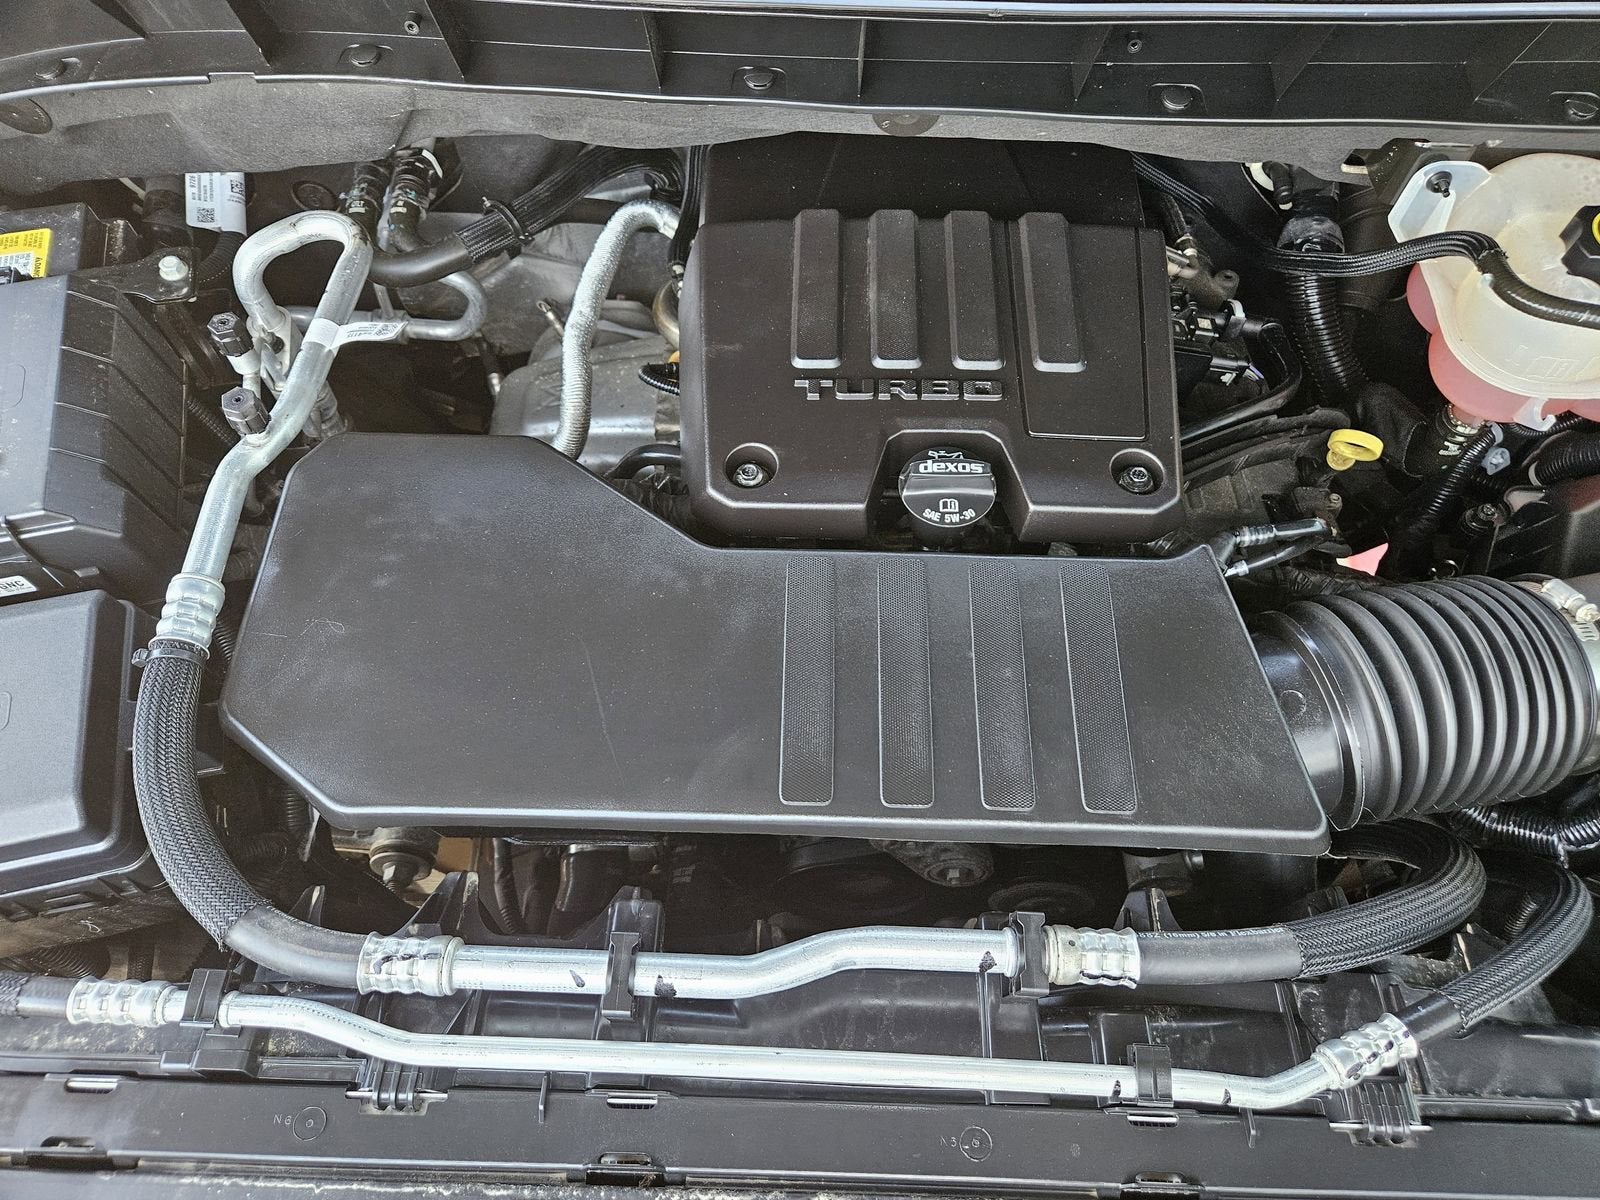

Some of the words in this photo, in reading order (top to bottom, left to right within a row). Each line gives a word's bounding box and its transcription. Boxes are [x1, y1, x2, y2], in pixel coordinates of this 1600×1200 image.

[794, 378, 1002, 400] TURBO
[918, 460, 985, 473] dexos
[923, 508, 941, 522] SAE
[944, 508, 976, 523] 5W-30
